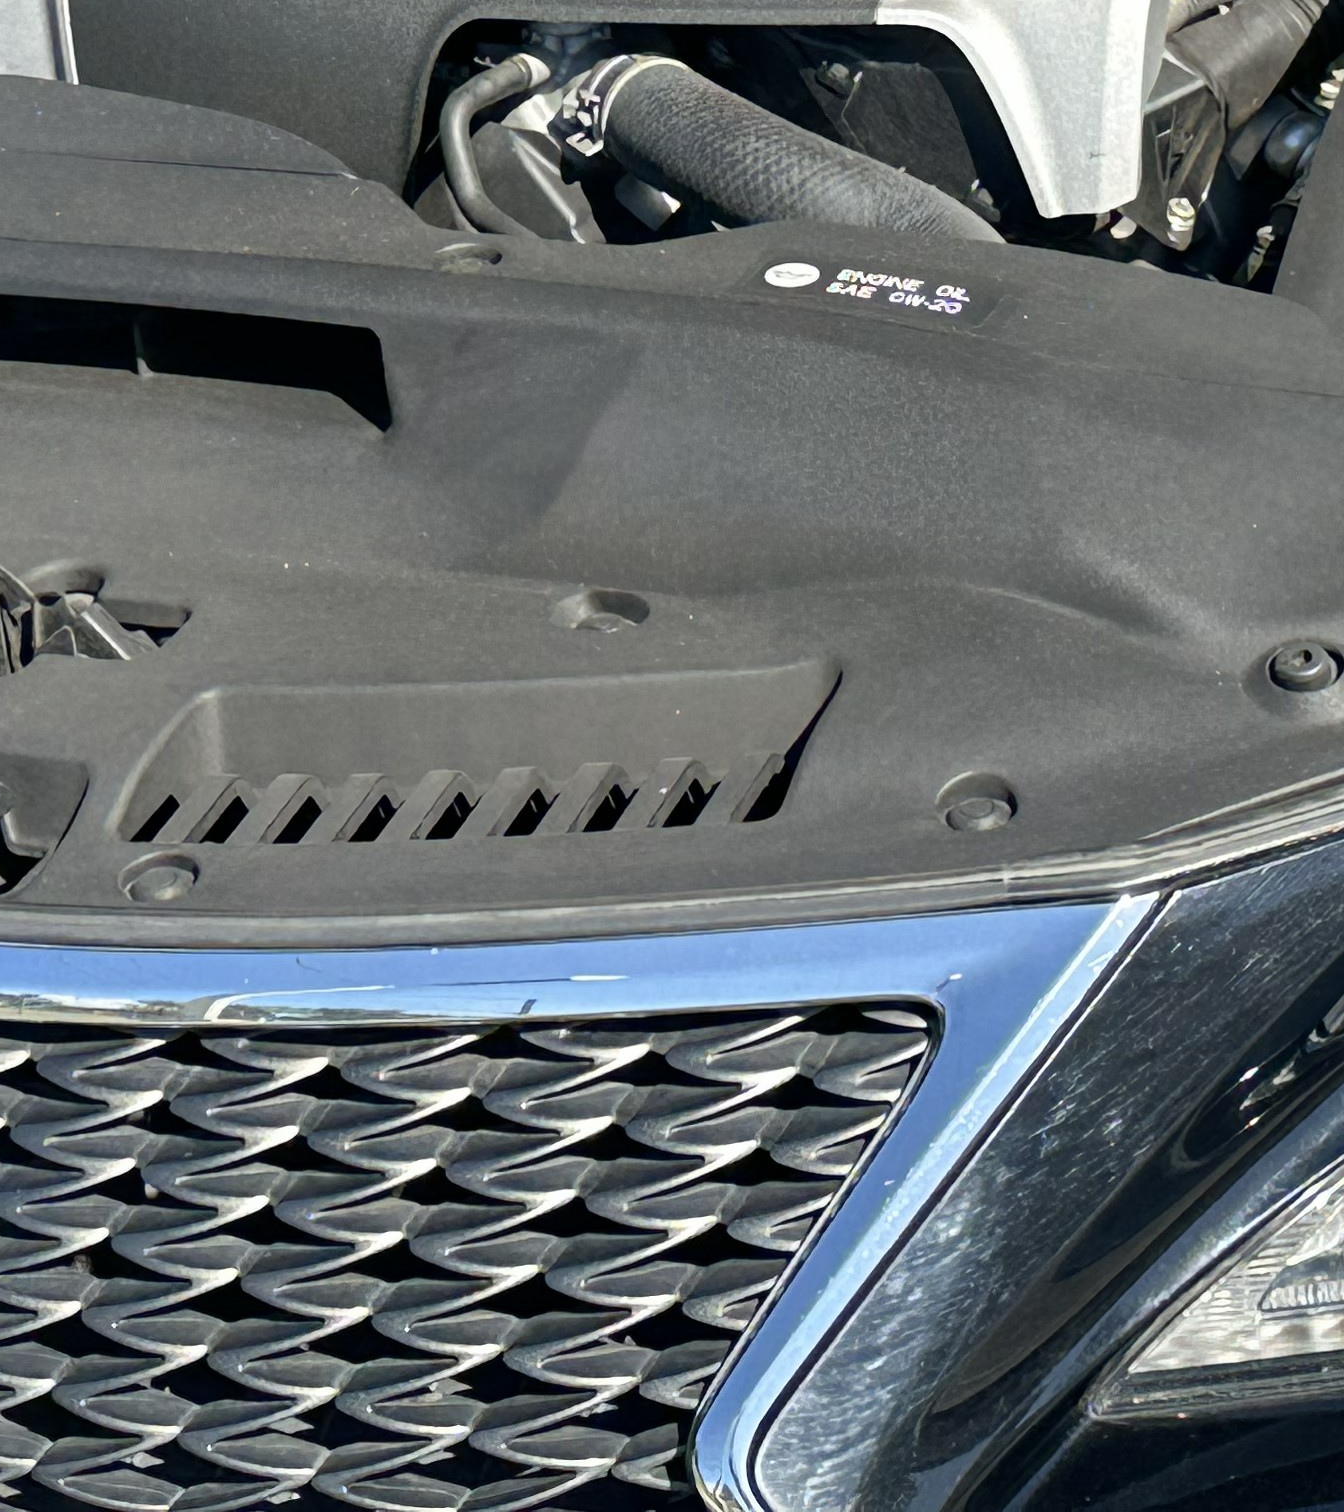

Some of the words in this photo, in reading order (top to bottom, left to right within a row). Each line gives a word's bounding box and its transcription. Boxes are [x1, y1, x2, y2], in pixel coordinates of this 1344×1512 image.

[825, 282, 878, 299] SAE
[836, 268, 925, 292] ENGINE
[935, 284, 971, 303] OIL
